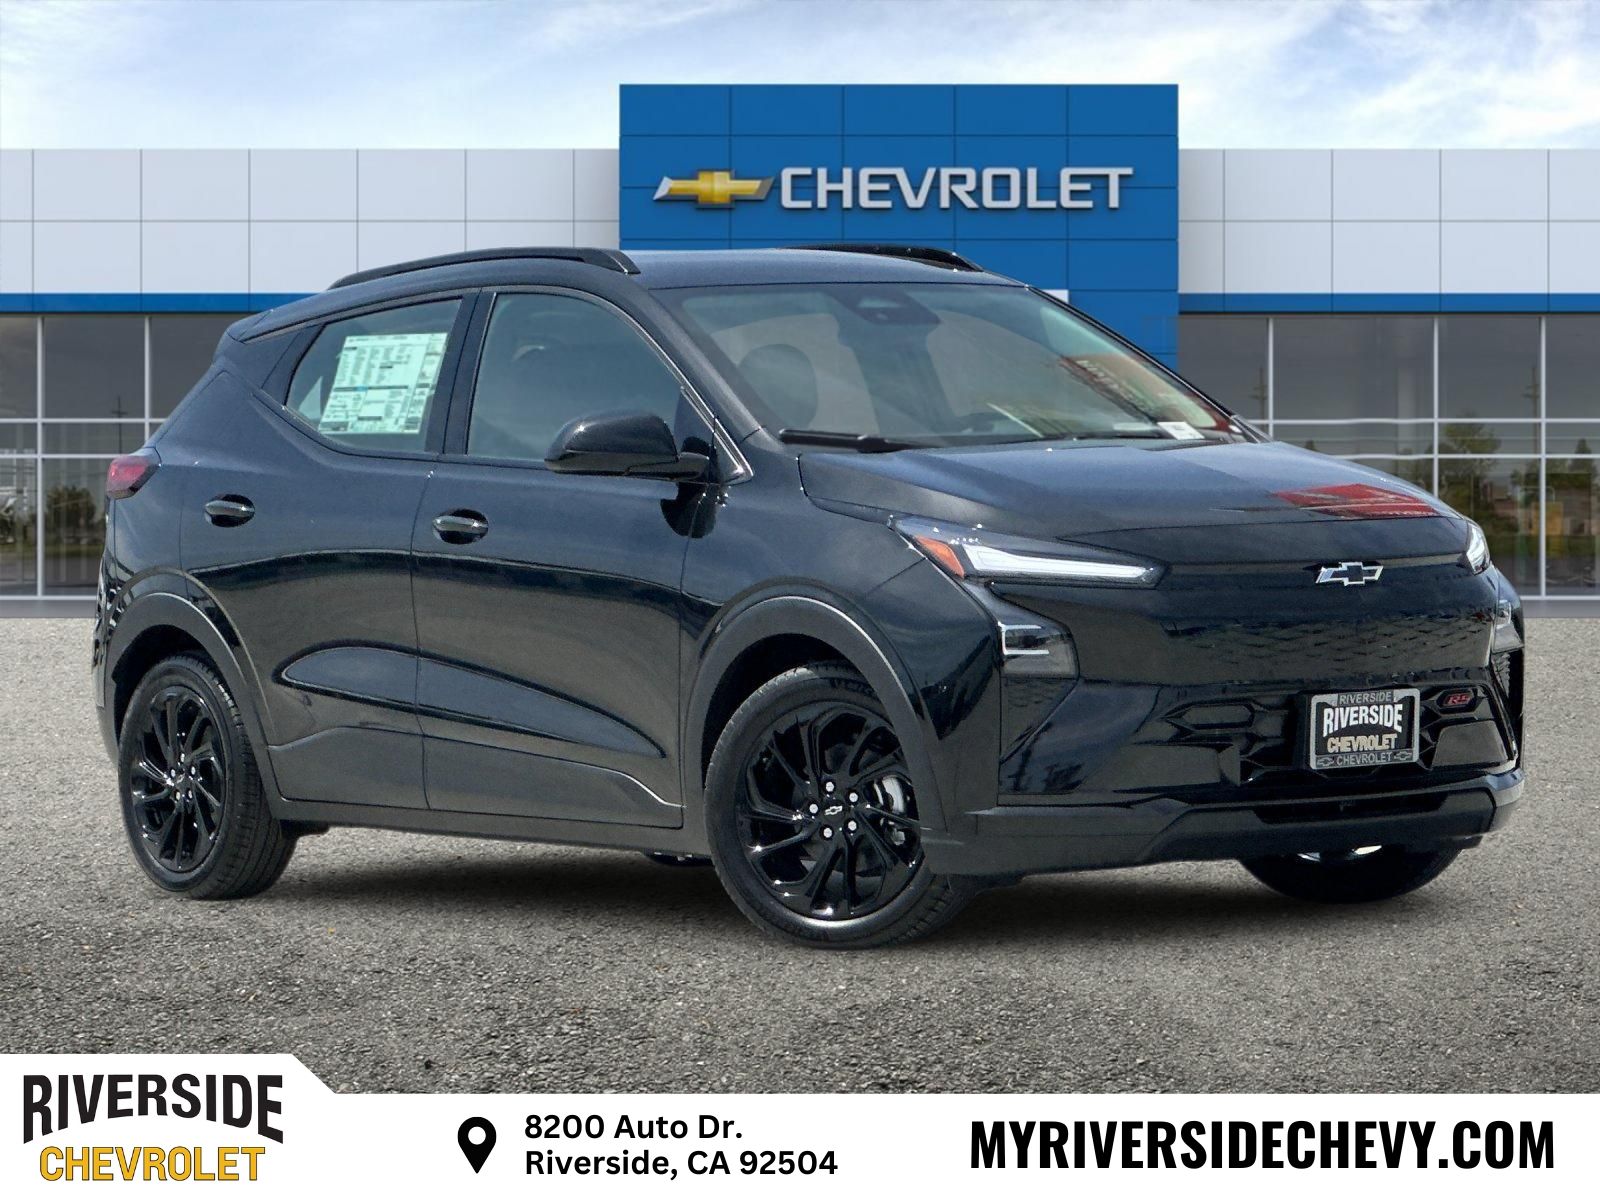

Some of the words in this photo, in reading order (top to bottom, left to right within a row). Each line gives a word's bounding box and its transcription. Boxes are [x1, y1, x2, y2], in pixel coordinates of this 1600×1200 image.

[780, 167, 1134, 209] CHEVROLET
[1340, 691, 1392, 704] RIVERSIDE
[1323, 703, 1403, 738] RIVERSIDE
[1327, 733, 1398, 753] CHEVROLET
[1336, 751, 1392, 766] CHEVROLET
